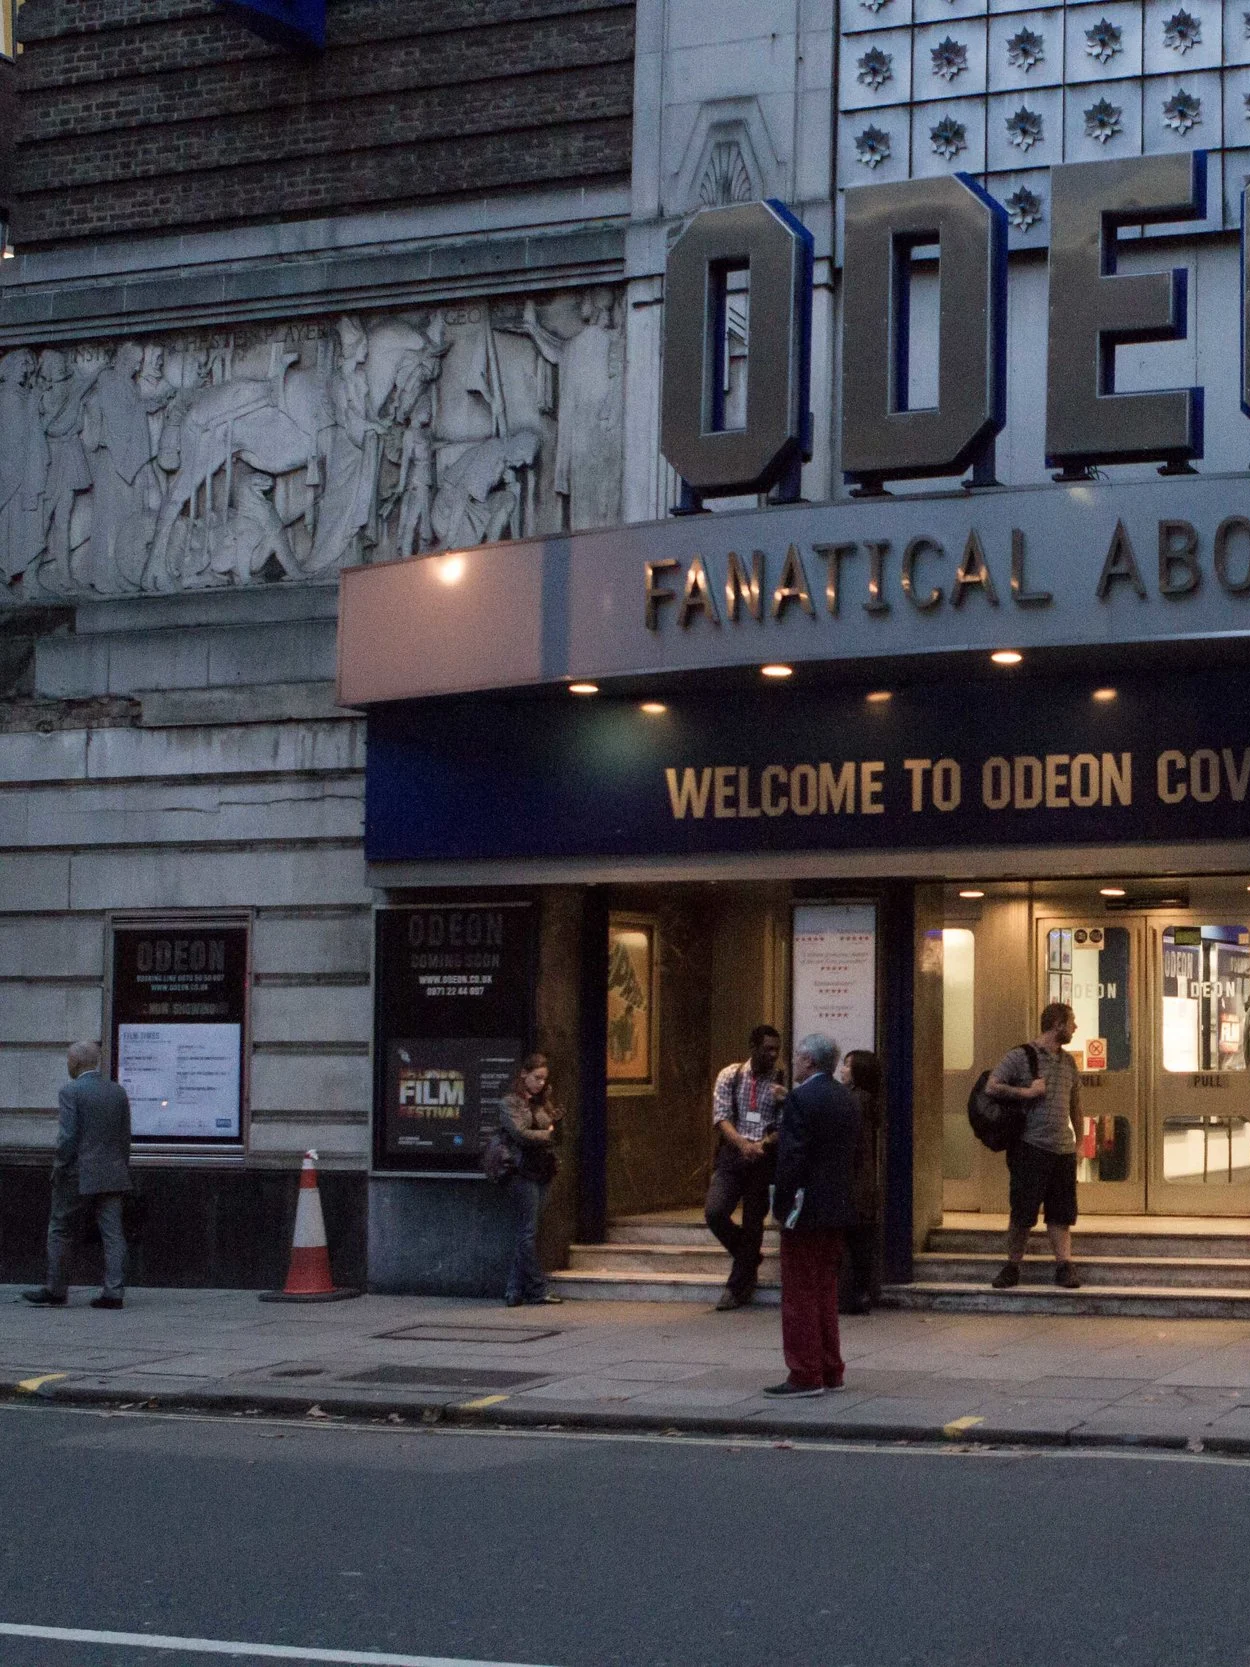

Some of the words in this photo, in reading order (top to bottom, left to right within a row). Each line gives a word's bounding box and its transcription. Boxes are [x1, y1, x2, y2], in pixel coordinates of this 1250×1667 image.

[644, 527, 1053, 631] FANATICAL
[665, 762, 885, 820] WELCOME
[904, 757, 961, 813] TO
[982, 752, 1132, 809] ODEON
[408, 912, 503, 946] ODEON
[136, 940, 225, 972] ODEON
[1074, 982, 1116, 998] DEON
[1191, 982, 1235, 997] DEON
[400, 1080, 464, 1104] FILM
[1080, 1075, 1101, 1087] ULL
[1193, 1075, 1223, 1088] PULL
